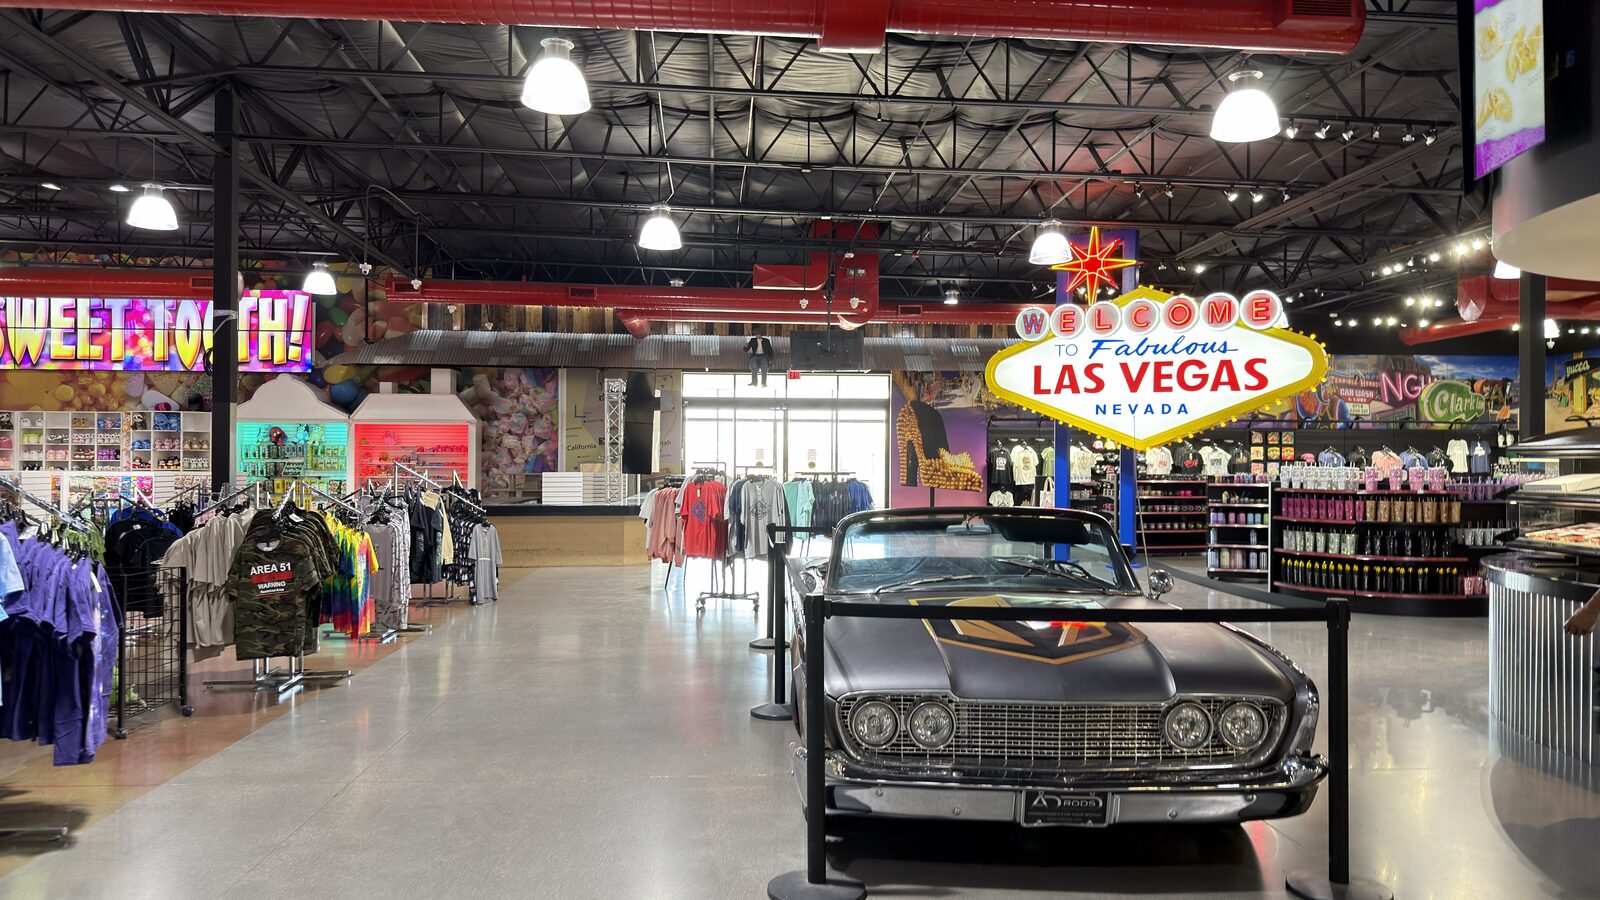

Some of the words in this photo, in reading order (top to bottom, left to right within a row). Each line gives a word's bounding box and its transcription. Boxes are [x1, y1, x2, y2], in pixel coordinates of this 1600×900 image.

[0, 297, 132, 365] WEET
[1022, 297, 1270, 335] WELCOME
[1054, 344, 1079, 357] TO
[1089, 335, 1239, 360] Fabulous
[1033, 362, 1106, 395] LAS
[1119, 357, 1269, 393] VEGAS
[1095, 403, 1189, 416] NEVADA
[251, 564, 278, 575] AREA
[280, 562, 291, 571] 51
